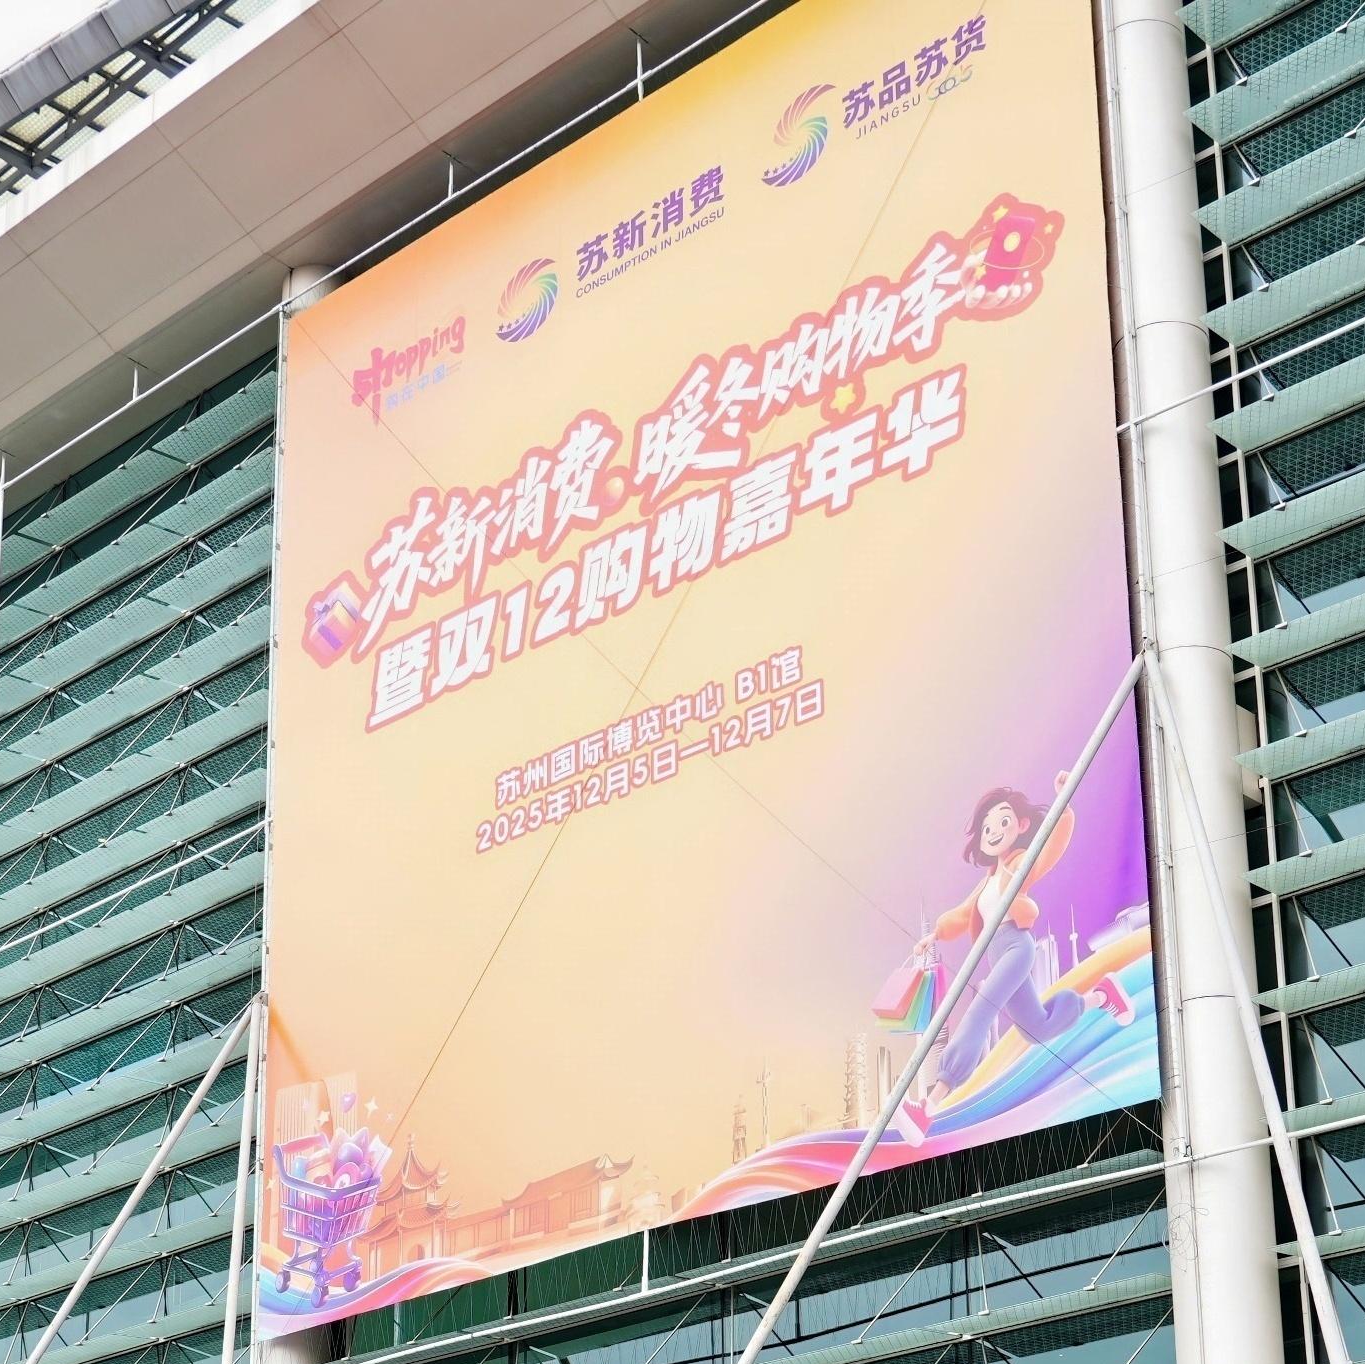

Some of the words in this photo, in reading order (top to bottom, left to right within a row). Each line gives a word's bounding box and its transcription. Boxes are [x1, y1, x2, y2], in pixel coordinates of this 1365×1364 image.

[842, 14, 986, 129] 苏品苏货
[856, 94, 921, 139] JIANGSU
[576, 165, 725, 282] 苏新消费
[576, 246, 657, 298] CONSUMPTION
[660, 236, 672, 251] IN
[675, 207, 725, 242] JIANGSU
[370, 369, 964, 727] 暨双12购物嘉年华
[496, 683, 723, 806] 苏州国际博览中心
[736, 648, 801, 702] B1馆
